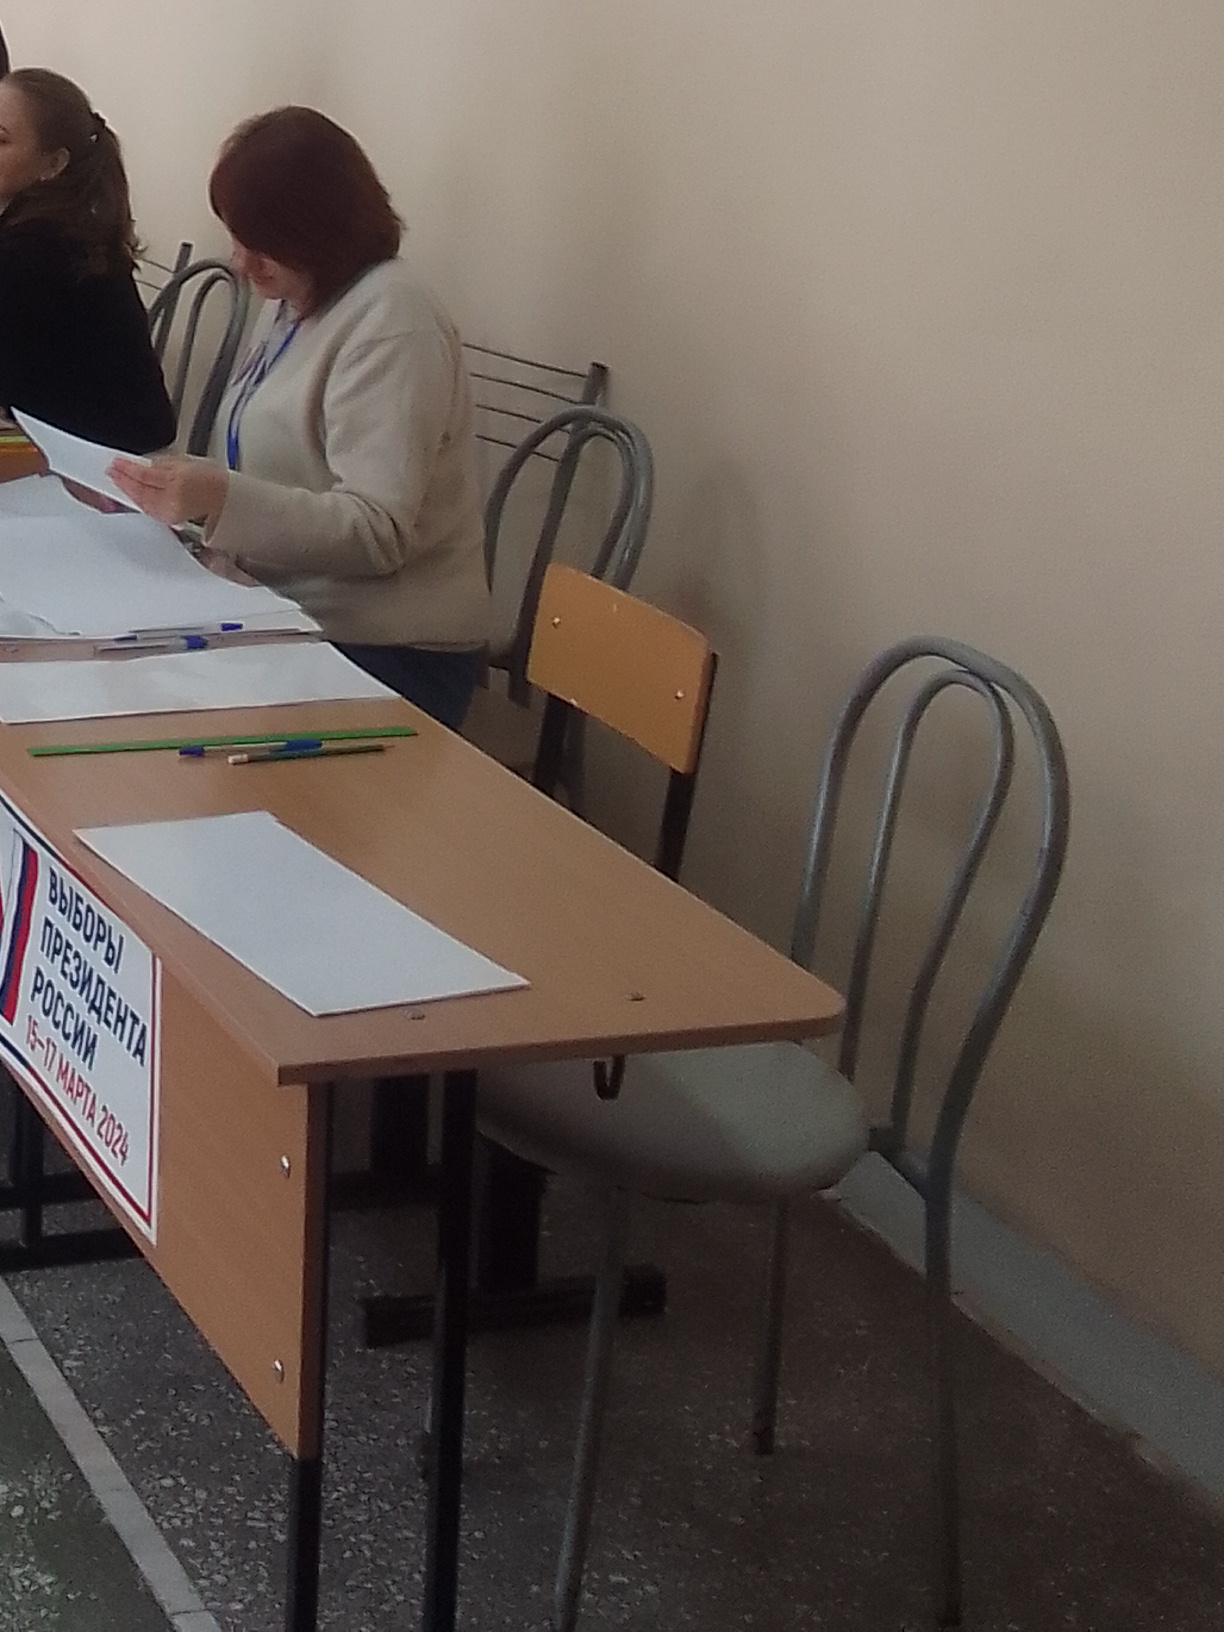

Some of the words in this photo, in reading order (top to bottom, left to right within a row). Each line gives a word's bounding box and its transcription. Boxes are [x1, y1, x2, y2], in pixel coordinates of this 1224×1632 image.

[49, 866, 124, 974] ВЫБОРЫ
[30, 965, 98, 1072] РОССИИ
[40, 915, 147, 1068] ПРЕЗИДЕНТА
[56, 1053, 96, 1128] МАРТА
[97, 1104, 129, 1167] 2024
